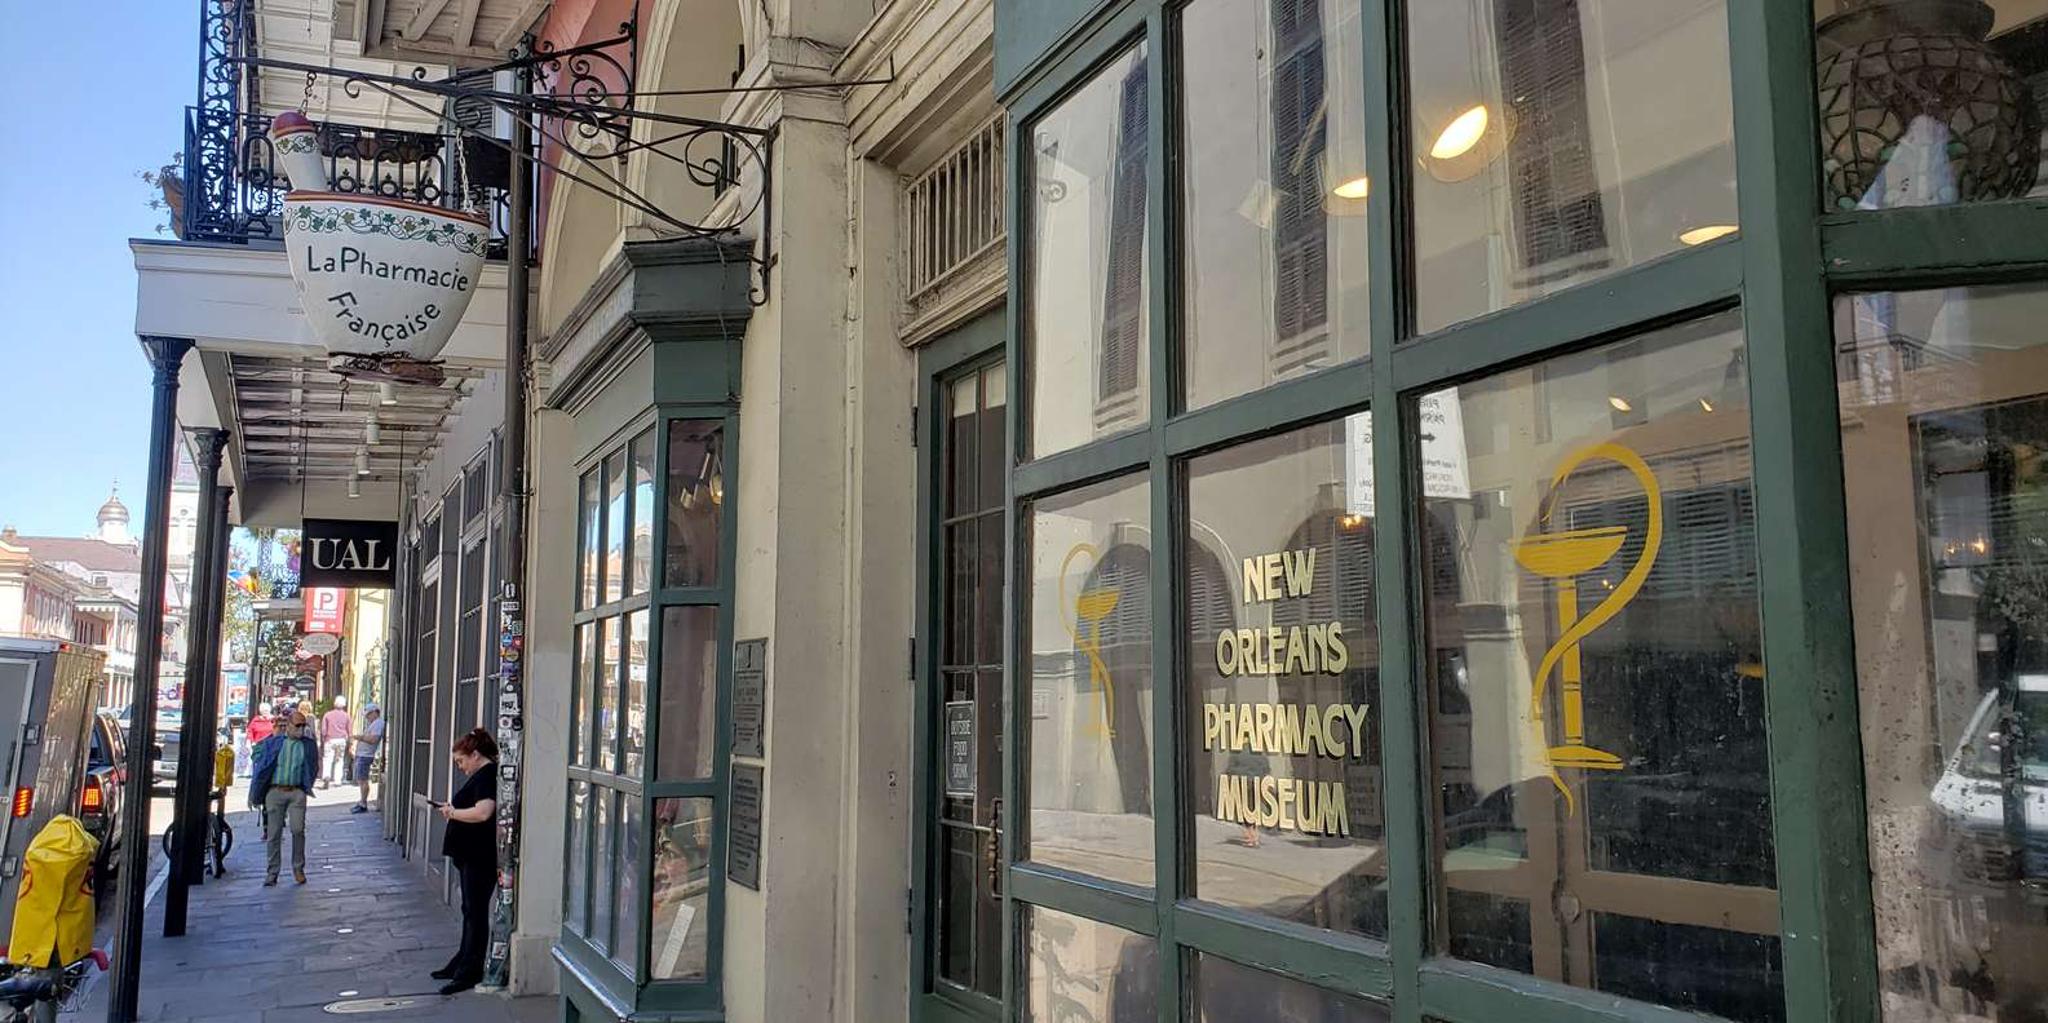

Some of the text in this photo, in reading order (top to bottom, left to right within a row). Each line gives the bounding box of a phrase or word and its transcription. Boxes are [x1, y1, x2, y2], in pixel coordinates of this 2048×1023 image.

[307, 245, 469, 292] La Pharmacie
[327, 291, 442, 347] Française
[309, 537, 391, 571] UAL
[1243, 547, 1316, 604] NEW
[1216, 620, 1349, 677] ORLEANS
[1203, 702, 1370, 760] PHARMACY
[1216, 773, 1350, 838] MUSEUM
